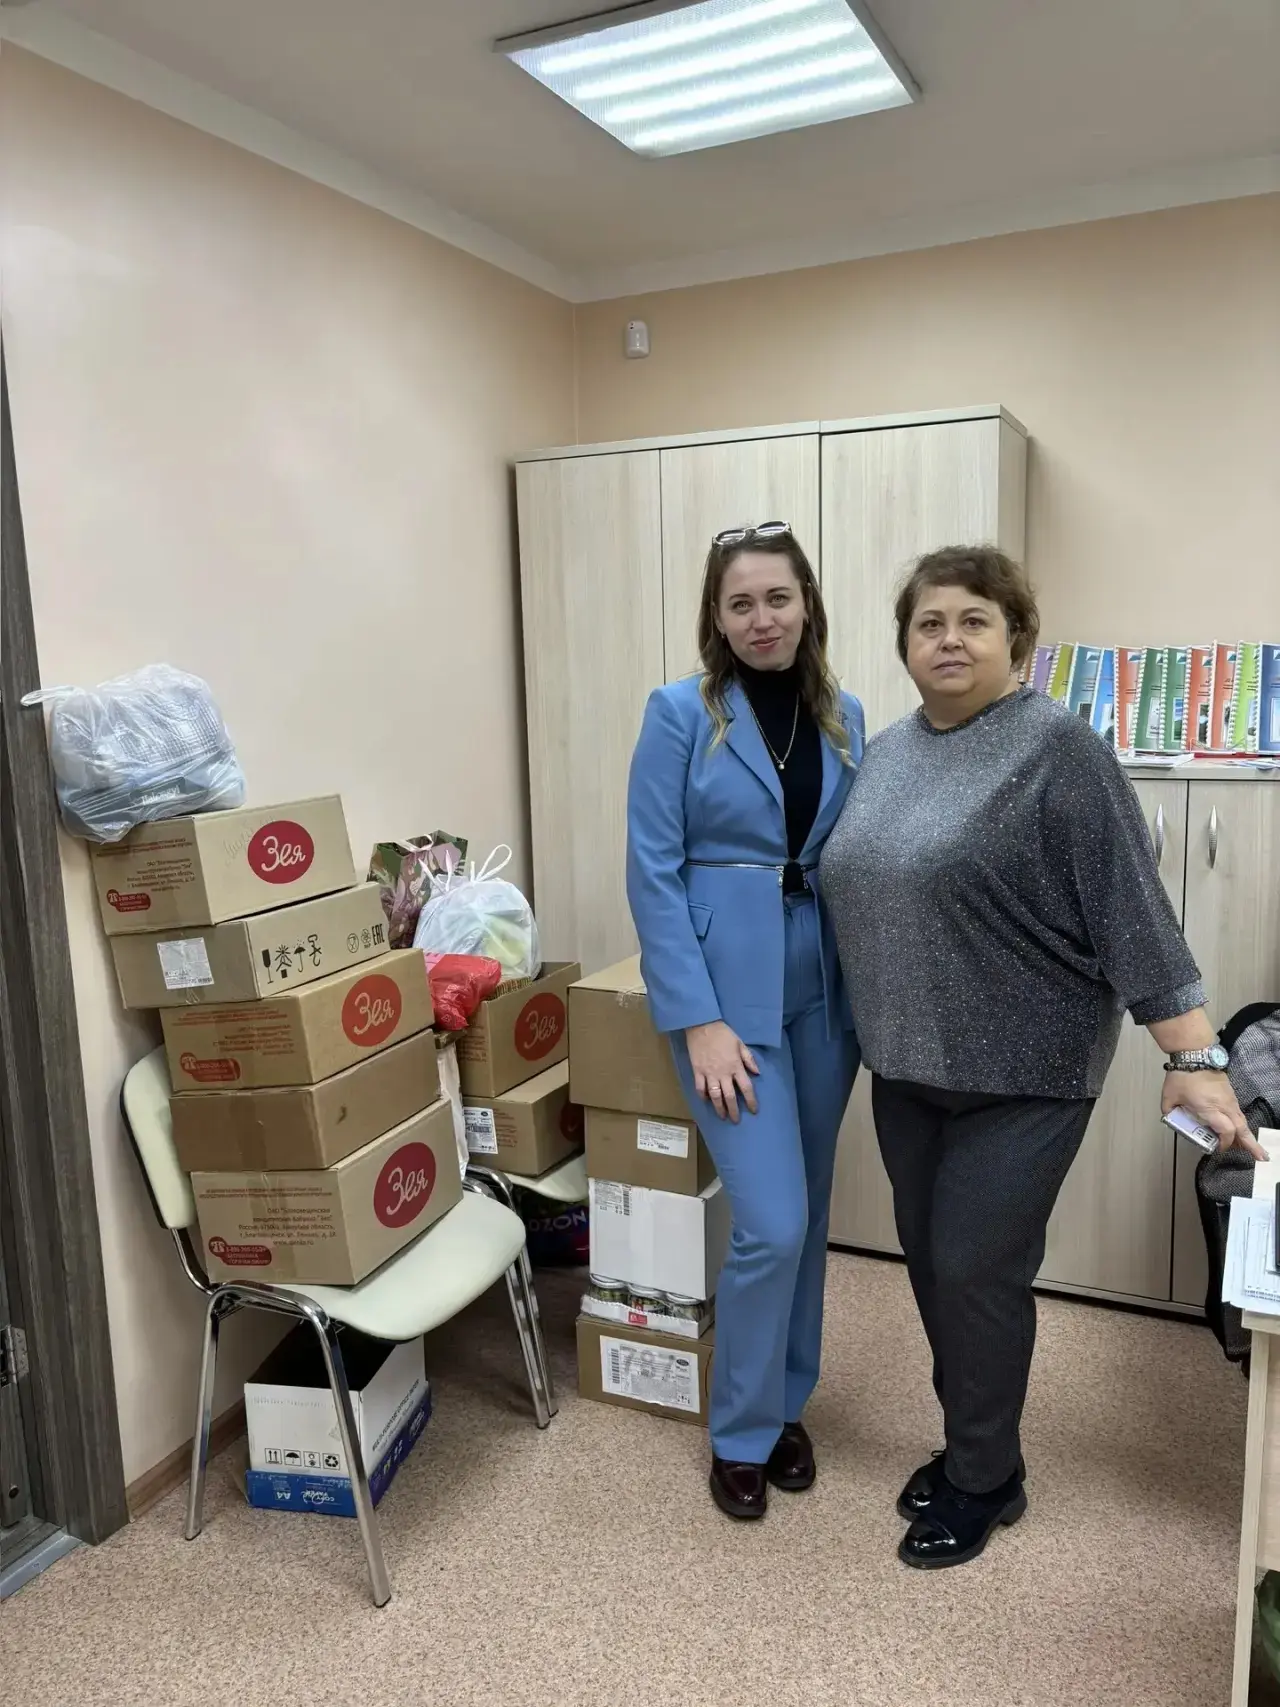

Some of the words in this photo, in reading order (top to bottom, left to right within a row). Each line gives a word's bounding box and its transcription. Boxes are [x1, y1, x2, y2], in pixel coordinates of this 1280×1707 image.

[261, 835, 306, 872] Зея
[353, 992, 395, 1035] Зея
[523, 1010, 559, 1049] Зея
[386, 1166, 428, 1216] Зея
[529, 1208, 587, 1231] OZON
